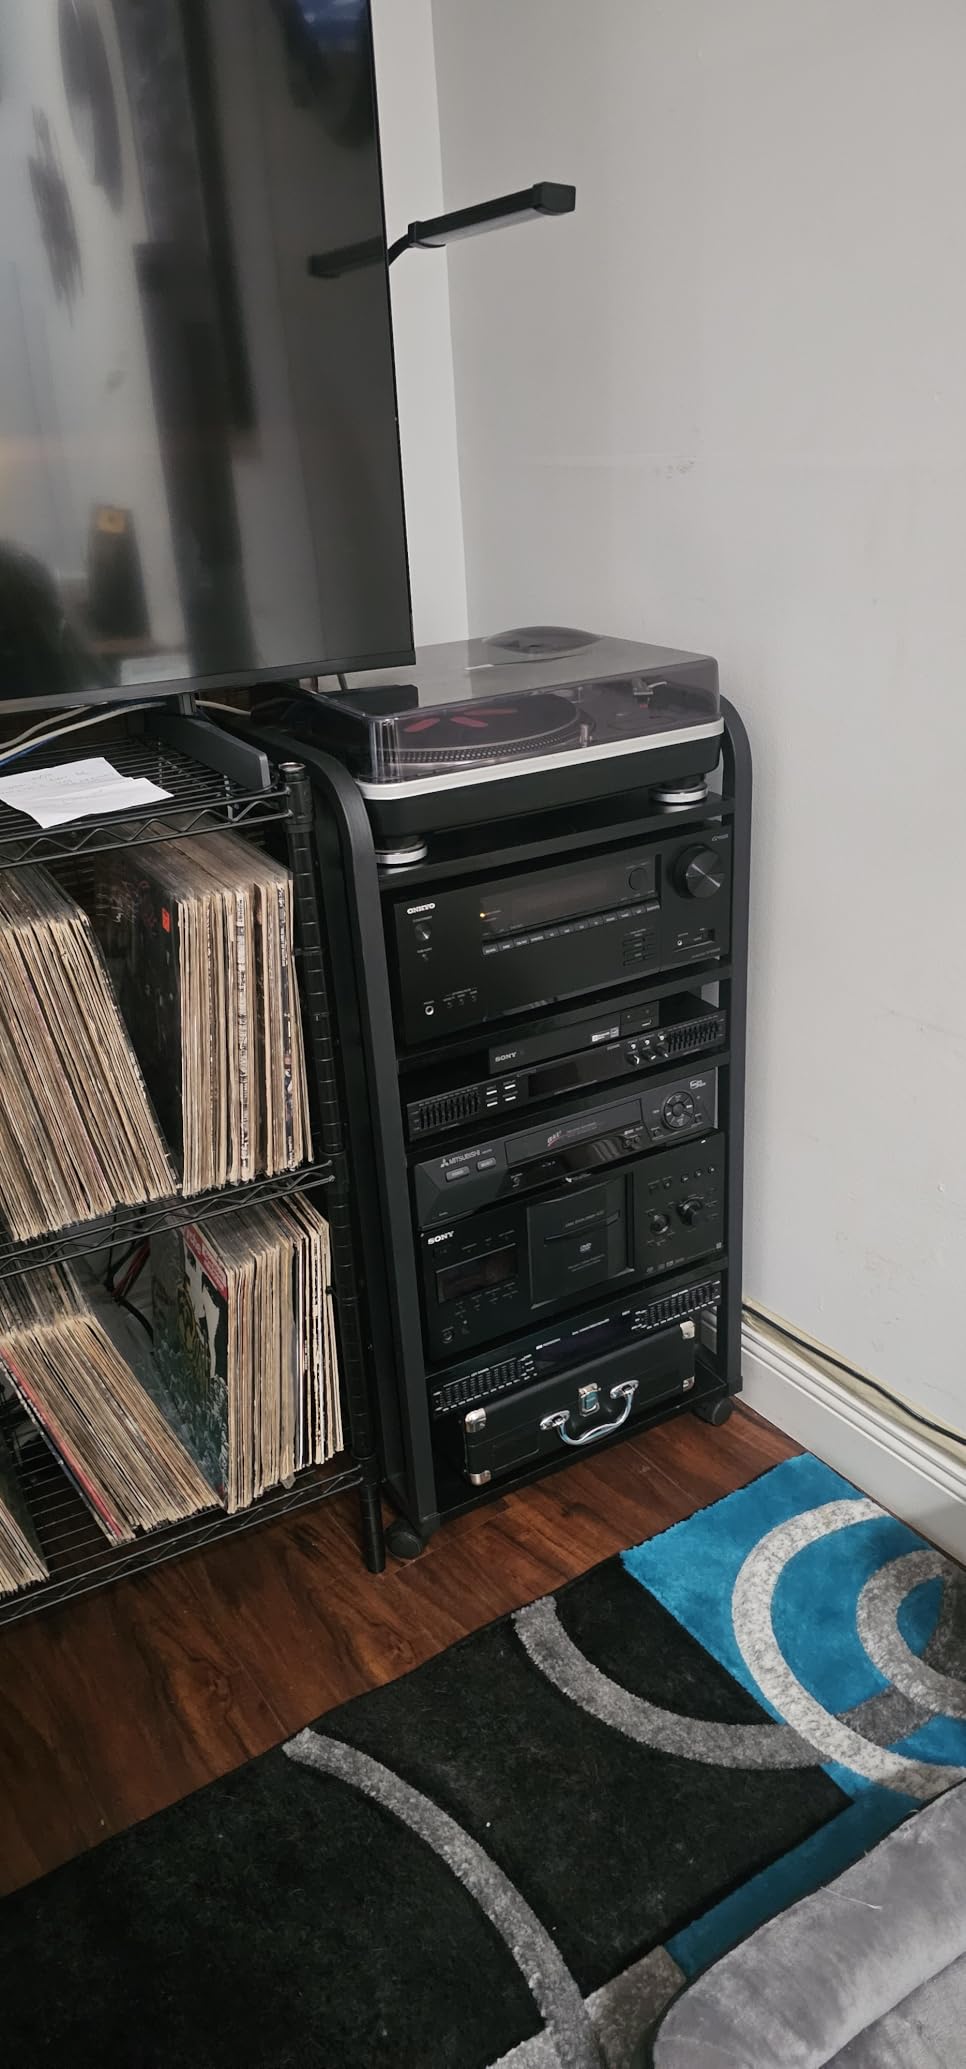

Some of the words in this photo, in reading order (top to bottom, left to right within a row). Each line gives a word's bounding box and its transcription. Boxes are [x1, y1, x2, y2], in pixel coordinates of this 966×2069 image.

[406, 902, 436, 915] ONKYO
[495, 1051, 517, 1063] SONY
[448, 1149, 481, 1164] MITSUBISHI
[427, 1230, 455, 1245] SONY
